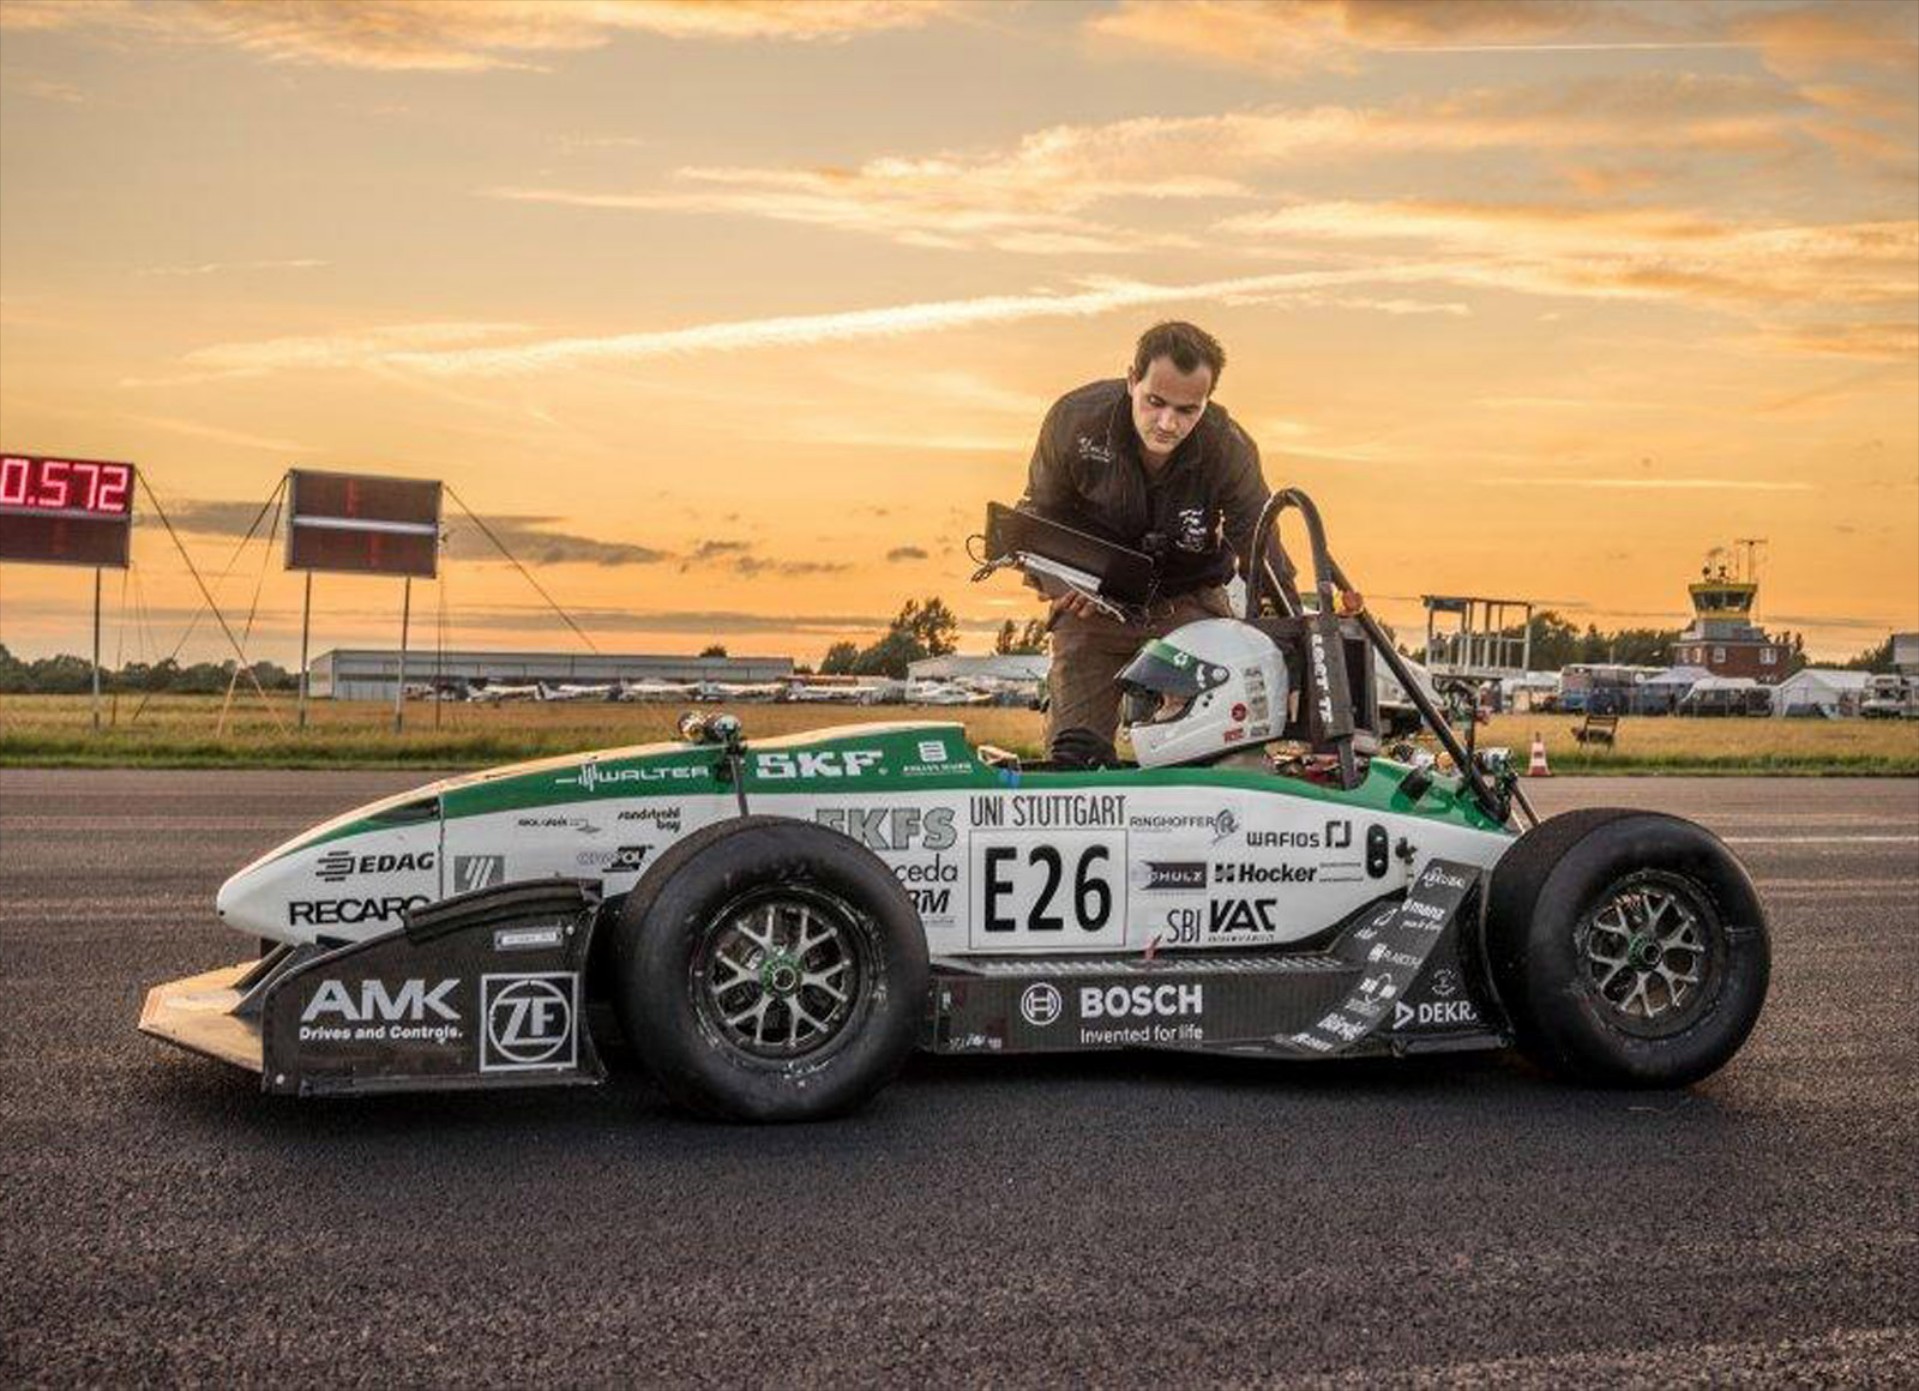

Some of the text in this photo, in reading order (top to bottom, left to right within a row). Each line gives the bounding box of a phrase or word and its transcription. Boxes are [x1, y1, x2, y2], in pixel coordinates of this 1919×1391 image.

[0, 459, 128, 511] 0.572
[600, 766, 709, 782] WALTER
[757, 751, 883, 778] SKF
[971, 795, 1126, 826] UNI STUTTGART
[1246, 831, 1320, 848] WAFIOS
[359, 852, 434, 873] EDAG
[984, 844, 1113, 932] E26
[1209, 898, 1277, 933] VAC
[301, 979, 462, 1020] AMK
[1080, 985, 1203, 1018] BOSCH
[1419, 1001, 1477, 1023] DEKR
[299, 1025, 351, 1040] Drives
[354, 1026, 385, 1039] and
[500, 998, 563, 1045] ZF
[1081, 1023, 1203, 1043] Invented for life
